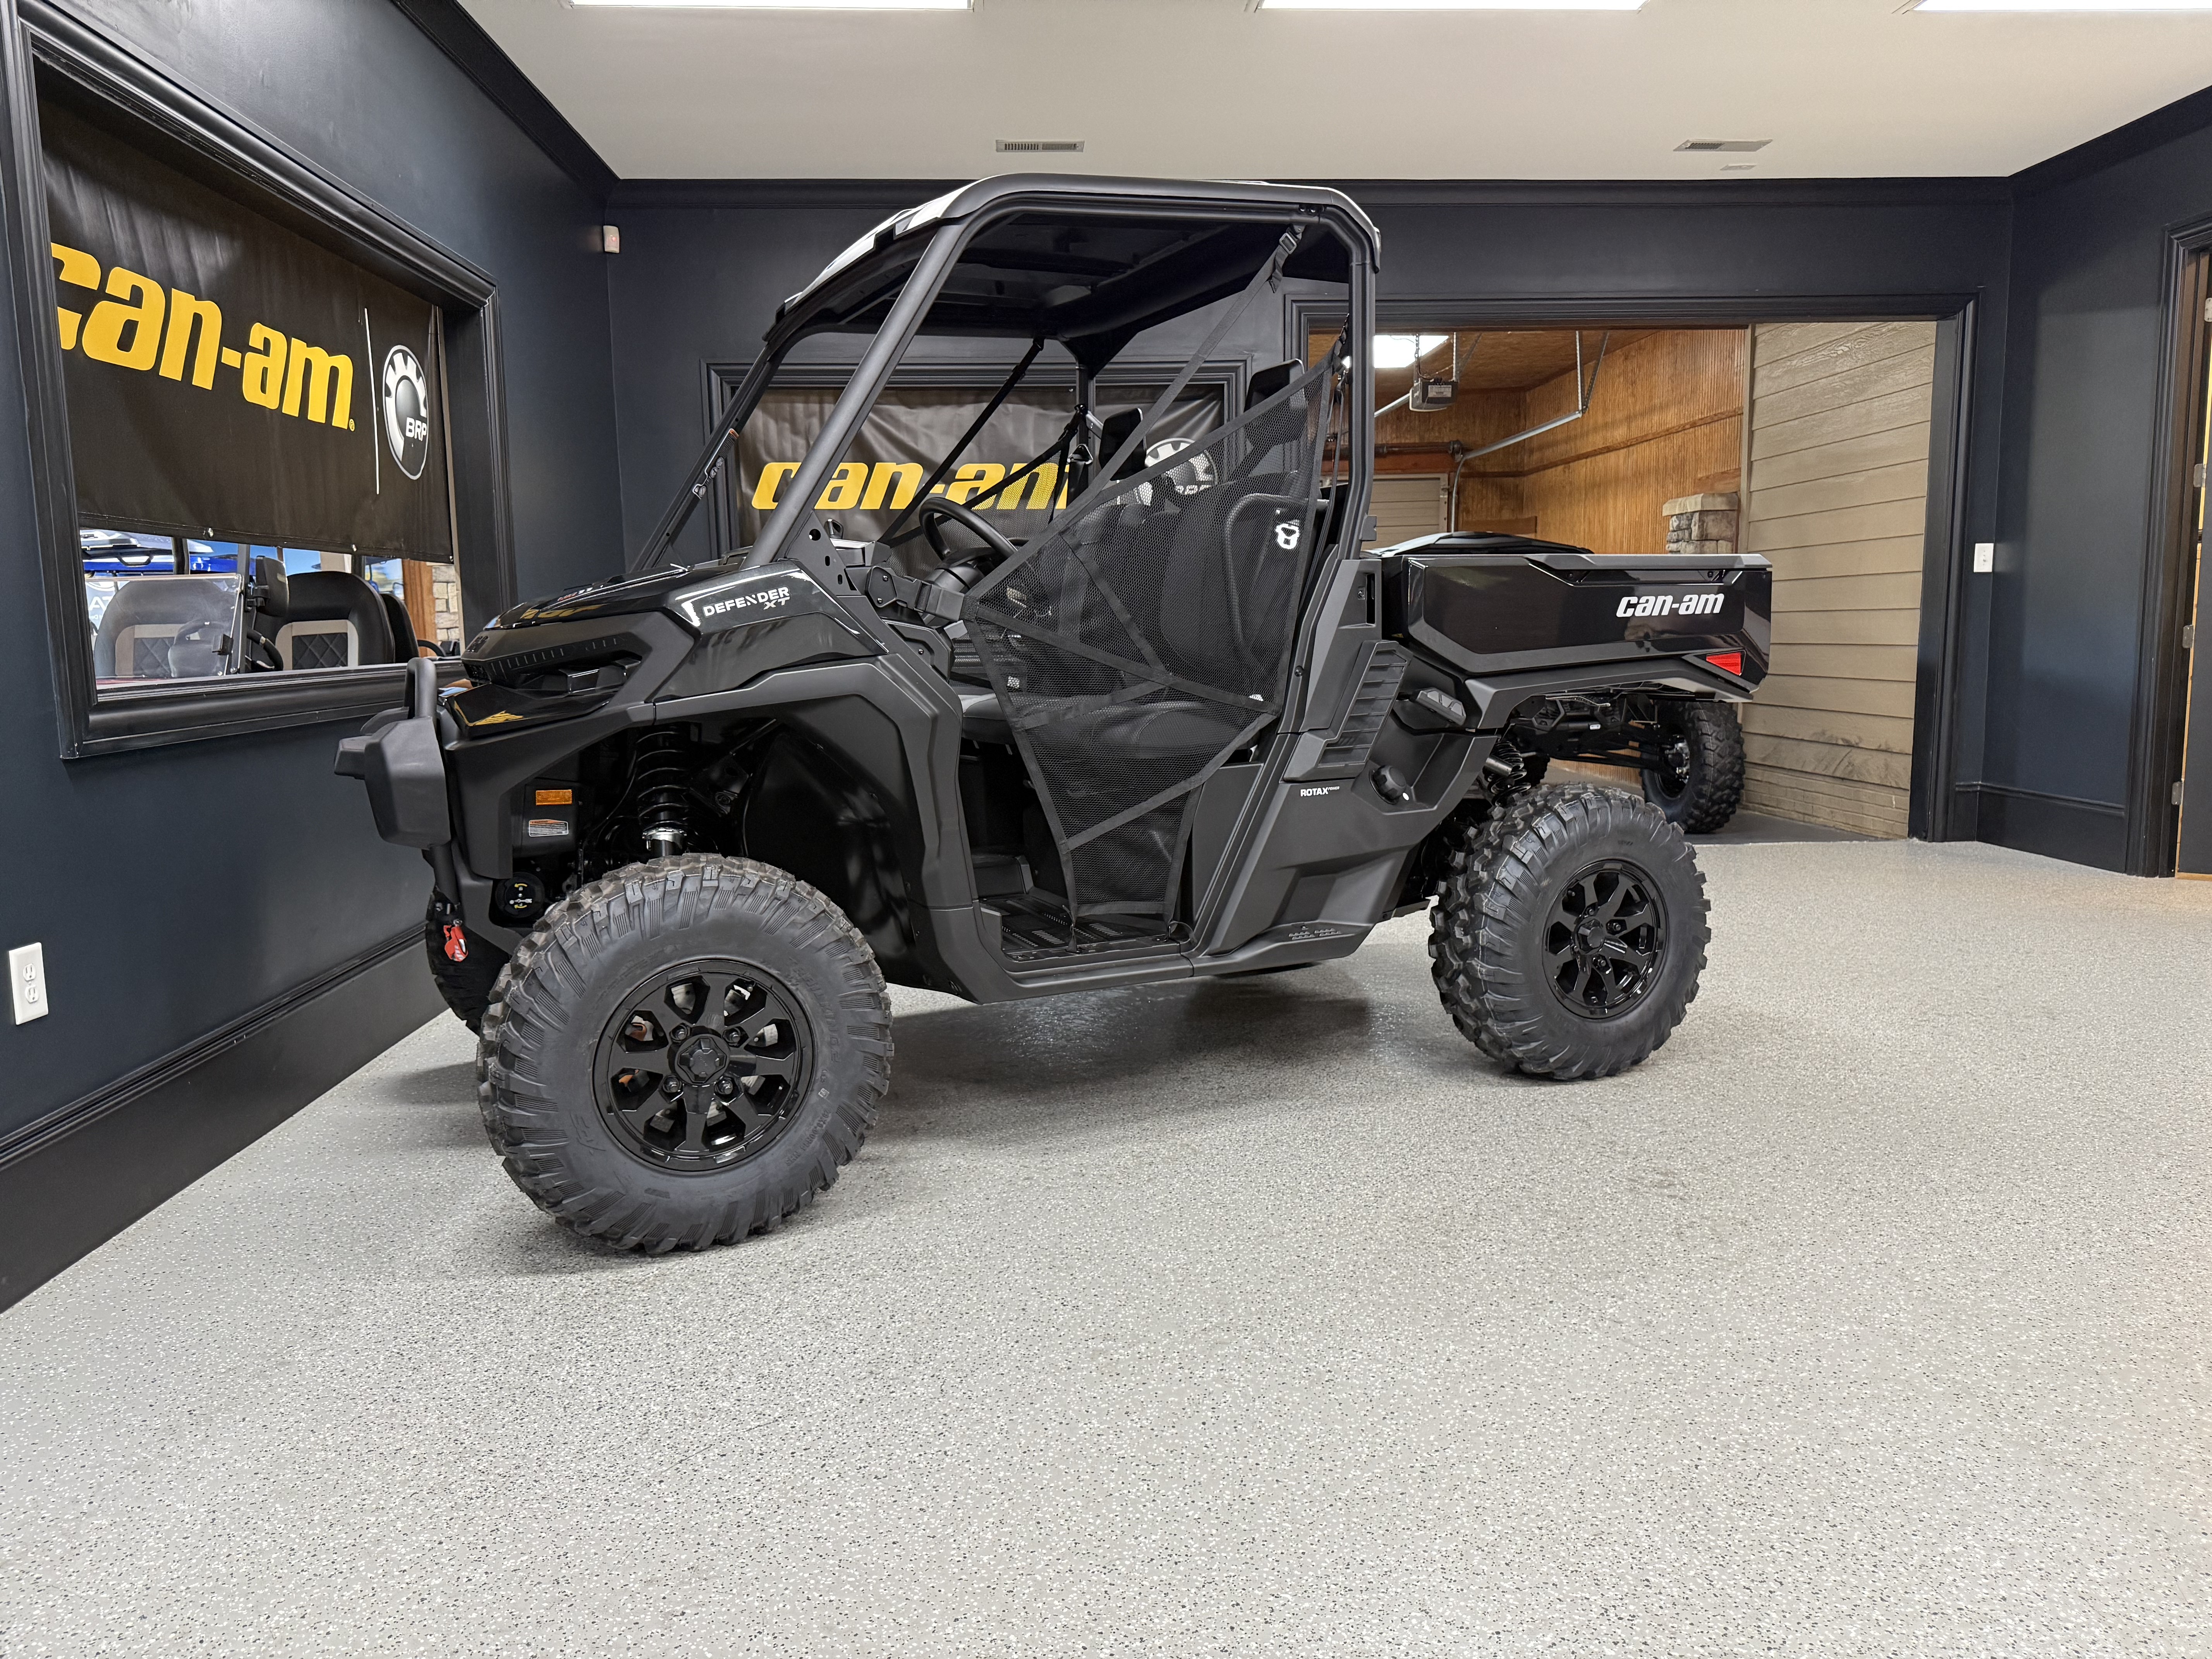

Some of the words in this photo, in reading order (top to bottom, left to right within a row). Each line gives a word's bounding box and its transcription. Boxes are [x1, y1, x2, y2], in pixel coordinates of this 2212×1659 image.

[406, 417, 427, 441] BRP
[703, 587, 790, 617] DEFENDER
[763, 596, 790, 610] XT
[1616, 593, 1724, 617] can-am
[1300, 787, 1329, 797] ROTAX
